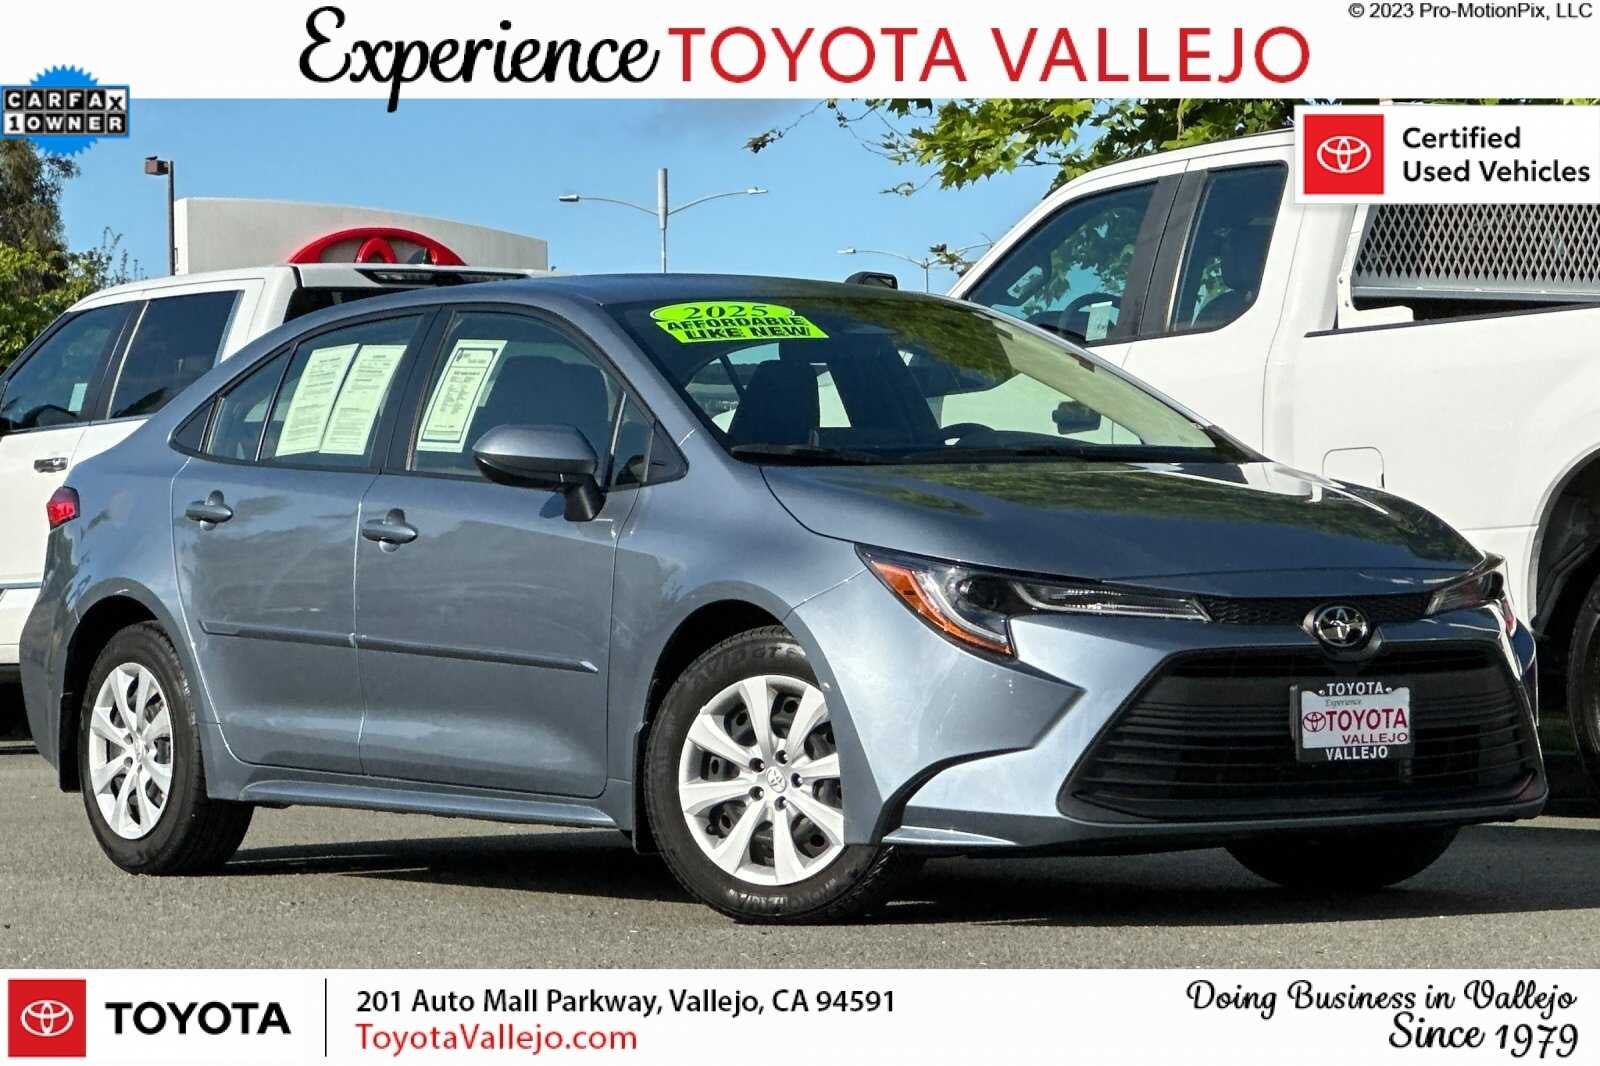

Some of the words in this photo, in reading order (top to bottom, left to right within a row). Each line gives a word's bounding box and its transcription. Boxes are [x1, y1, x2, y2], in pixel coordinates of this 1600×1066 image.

[684, 305, 769, 319] 2025
[667, 315, 804, 330] AFFORDABLE
[684, 327, 743, 340] LIKE
[1326, 681, 1384, 696] TOYOTA
[1325, 707, 1408, 732] TOYOTA
[1342, 732, 1408, 745] VALLEJO
[1325, 746, 1388, 761] VALLEJO
